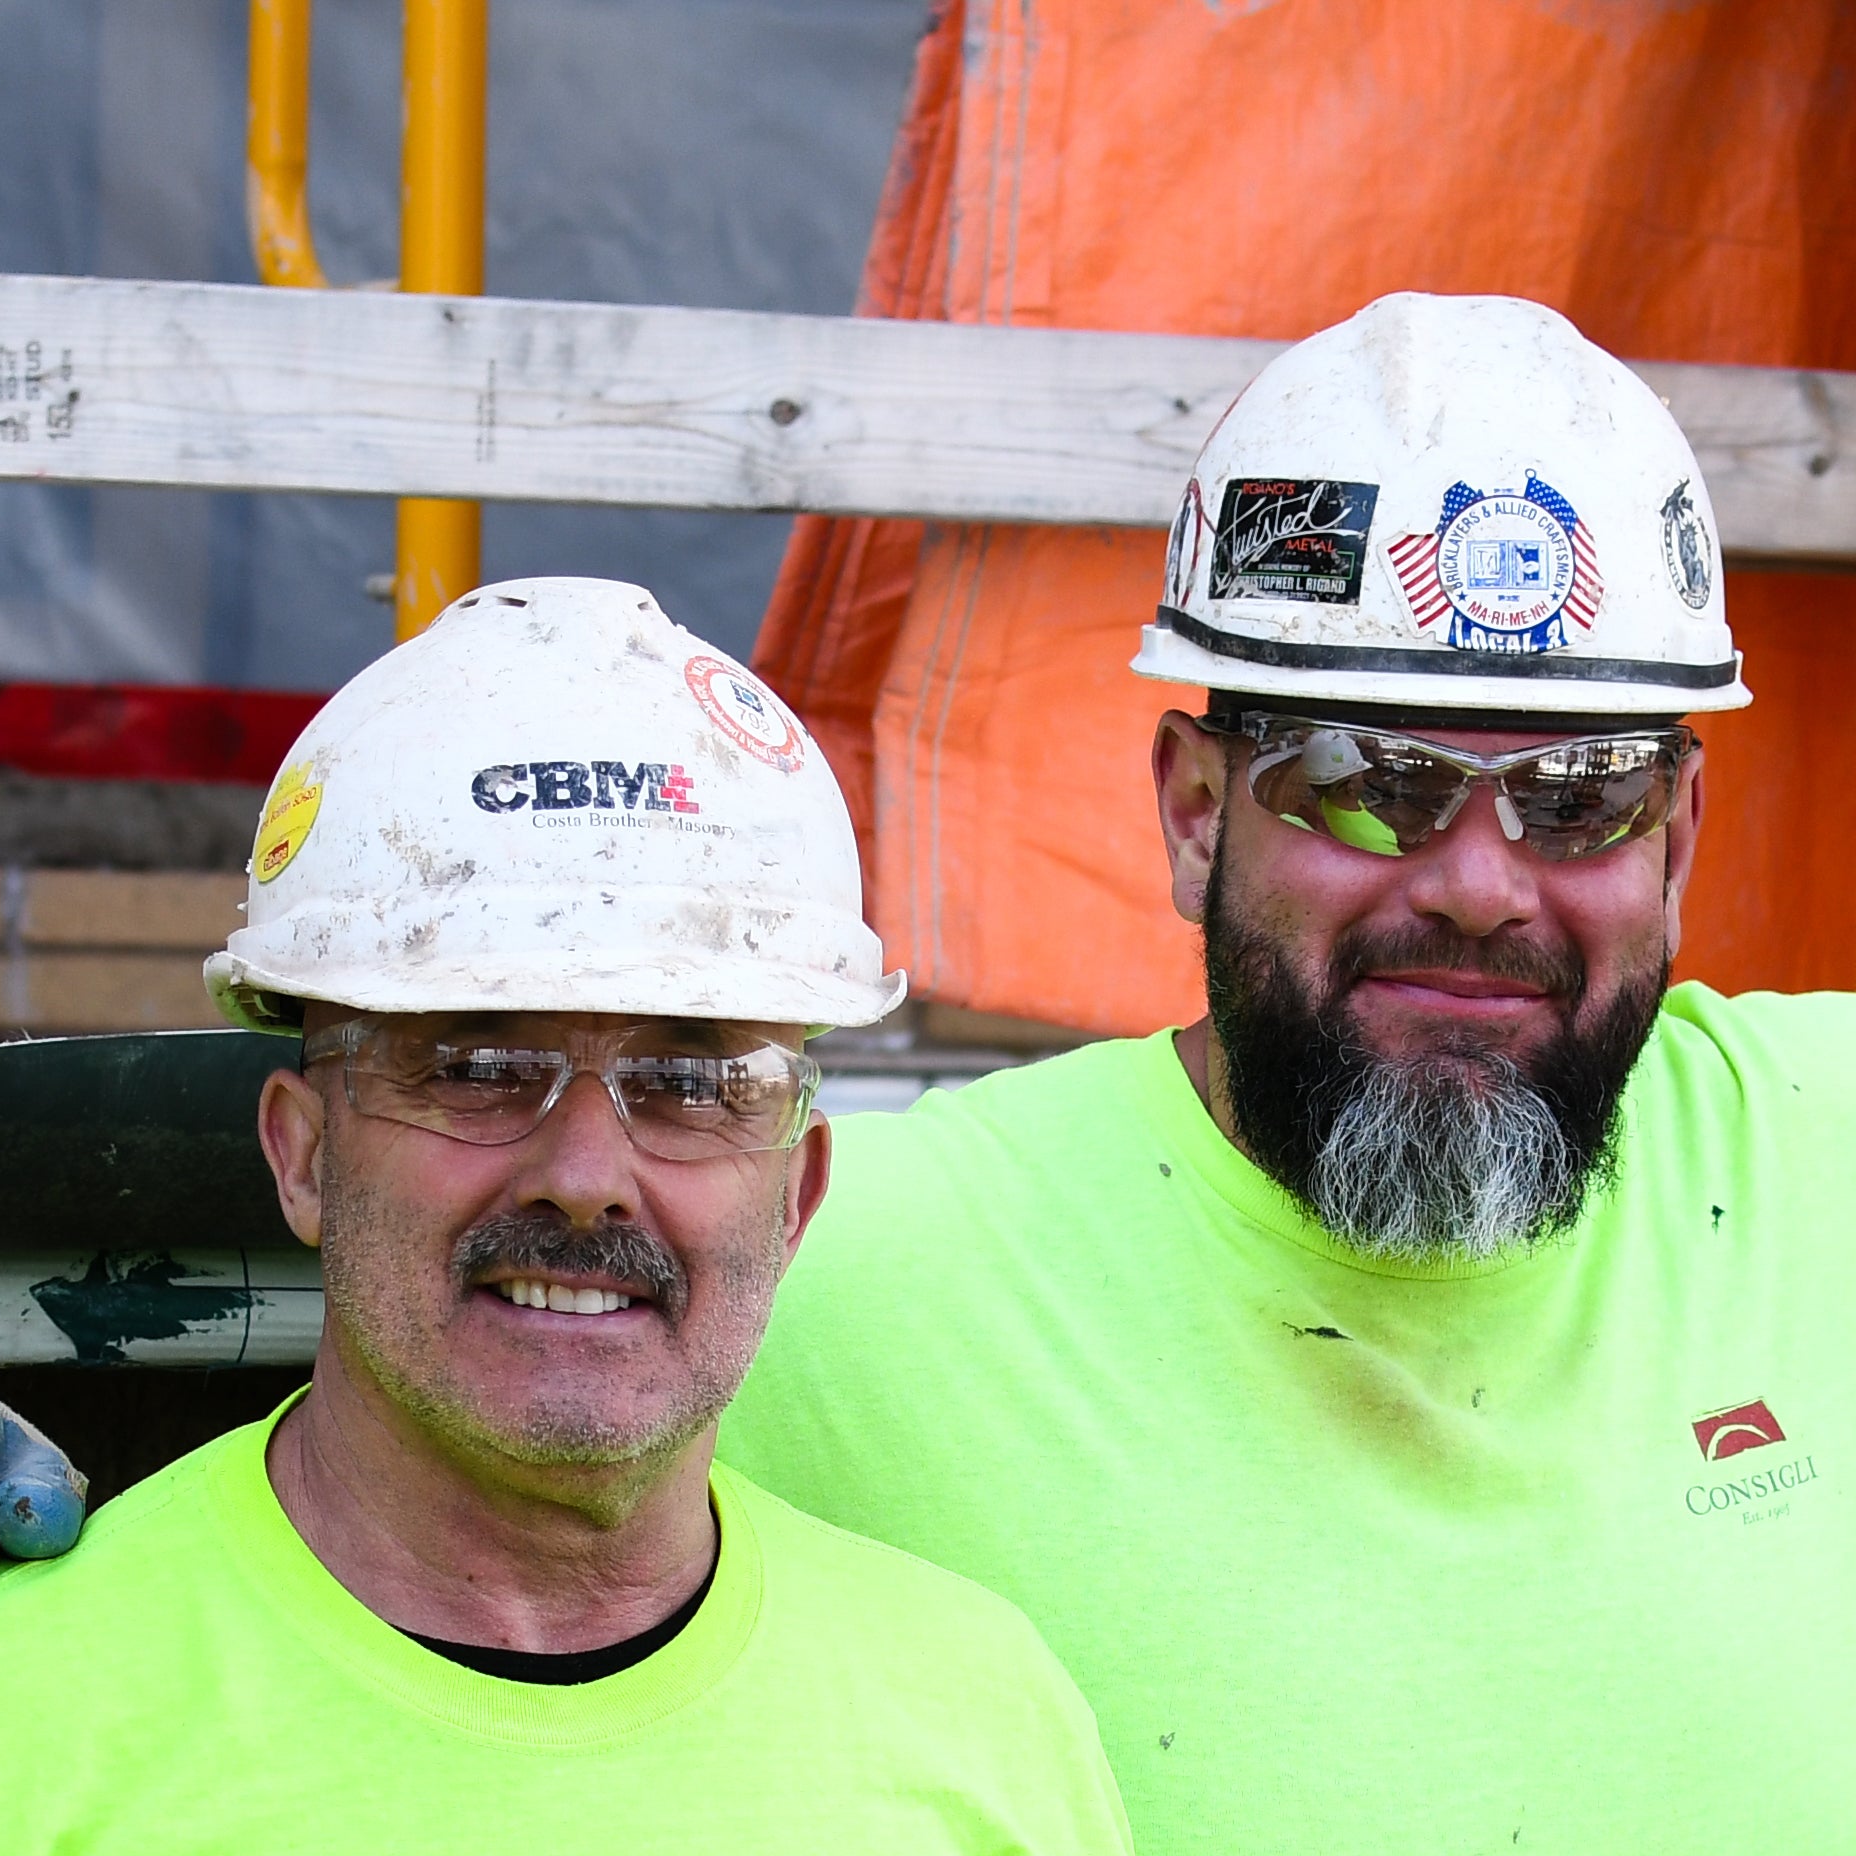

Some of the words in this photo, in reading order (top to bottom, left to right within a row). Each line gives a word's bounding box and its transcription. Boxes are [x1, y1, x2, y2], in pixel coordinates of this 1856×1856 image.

[1284, 538, 1337, 553] METAL
[1447, 511, 1481, 589] BRICKLAYERS
[1482, 505, 1492, 518] &
[1495, 502, 1537, 520] ALLIED
[1537, 515, 1569, 590] CRAFTSMEN
[471, 761, 673, 814] CBM
[532, 814, 582, 829] Costa
[1685, 1455, 1820, 1515] CONSIGLI
